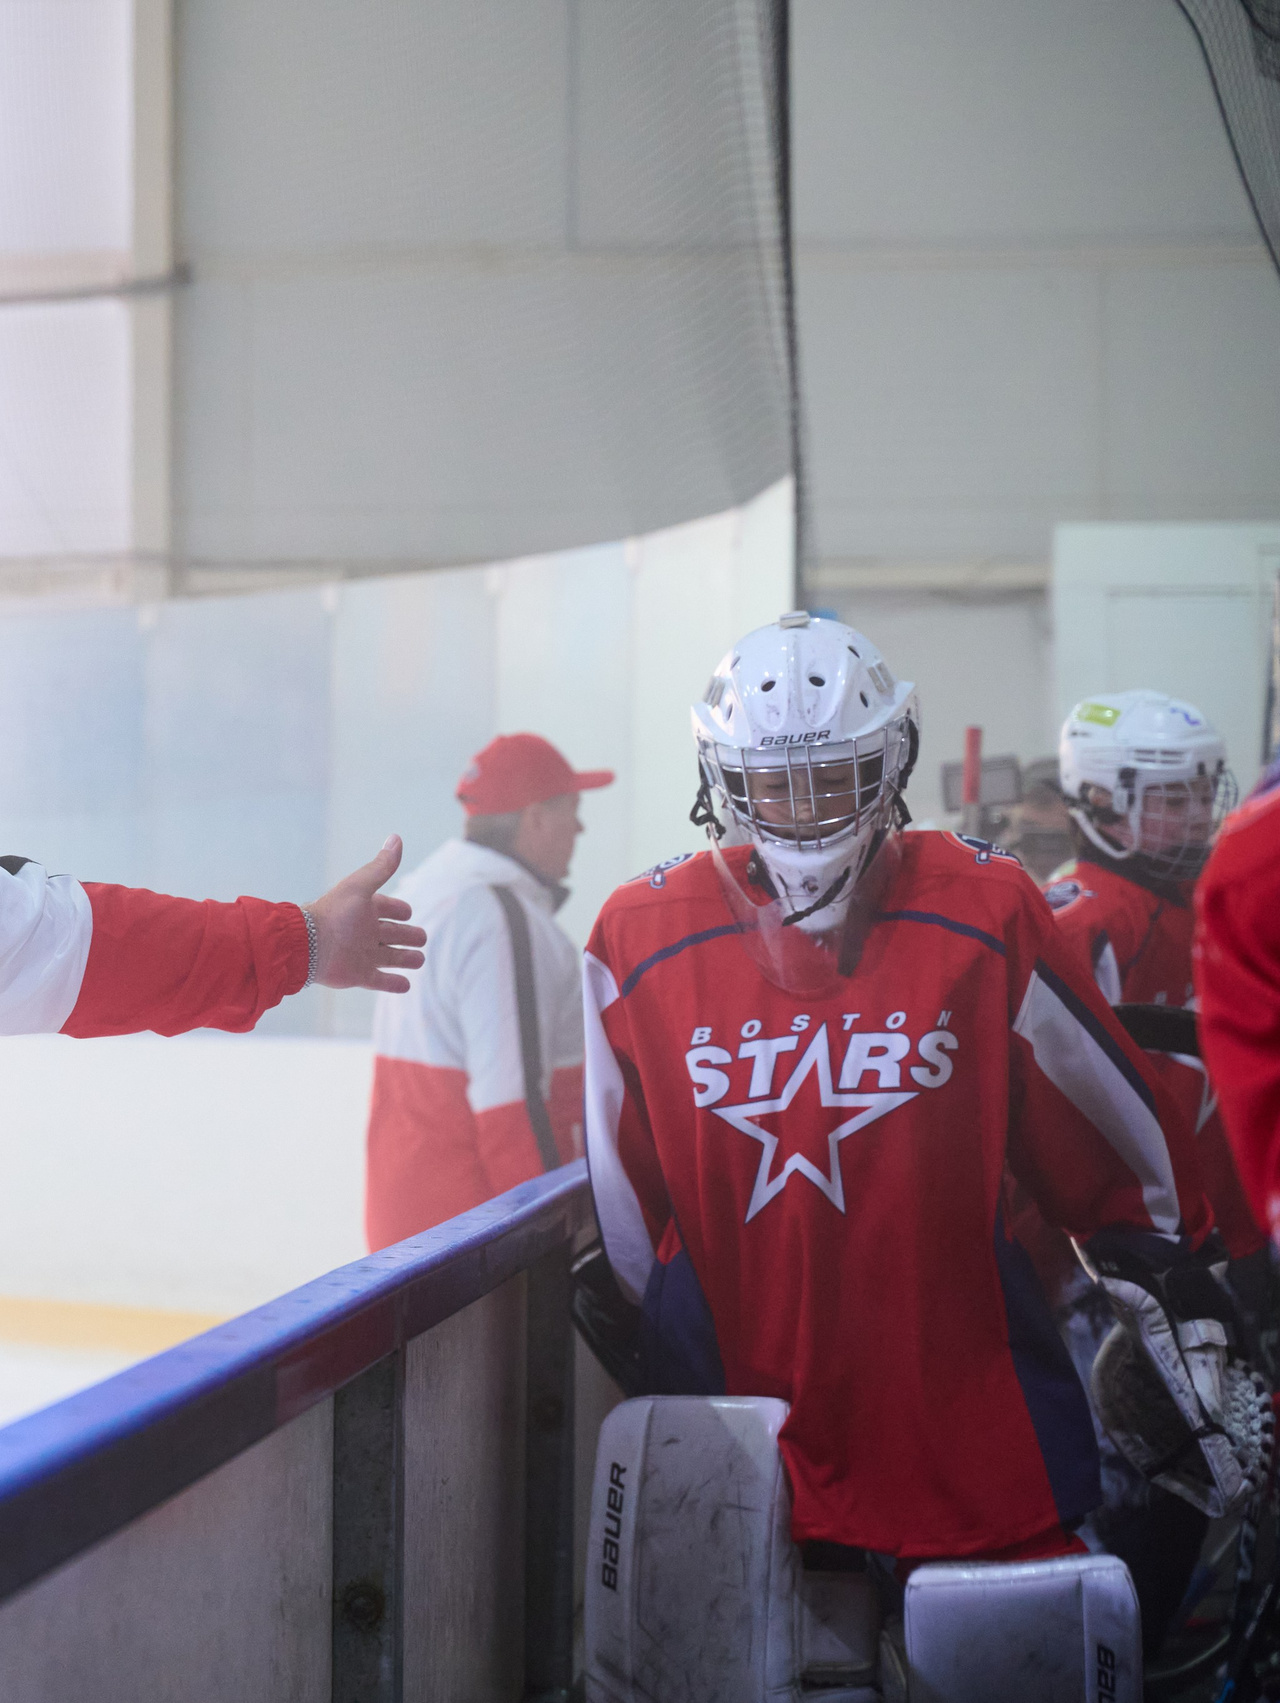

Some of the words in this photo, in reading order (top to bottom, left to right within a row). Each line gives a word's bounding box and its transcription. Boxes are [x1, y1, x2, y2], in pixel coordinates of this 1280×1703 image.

[760, 729, 831, 746] BAUER
[690, 1010, 952, 1046] BOSTON
[685, 1022, 959, 1107] STARS
[601, 1461, 627, 1592] BAUER
